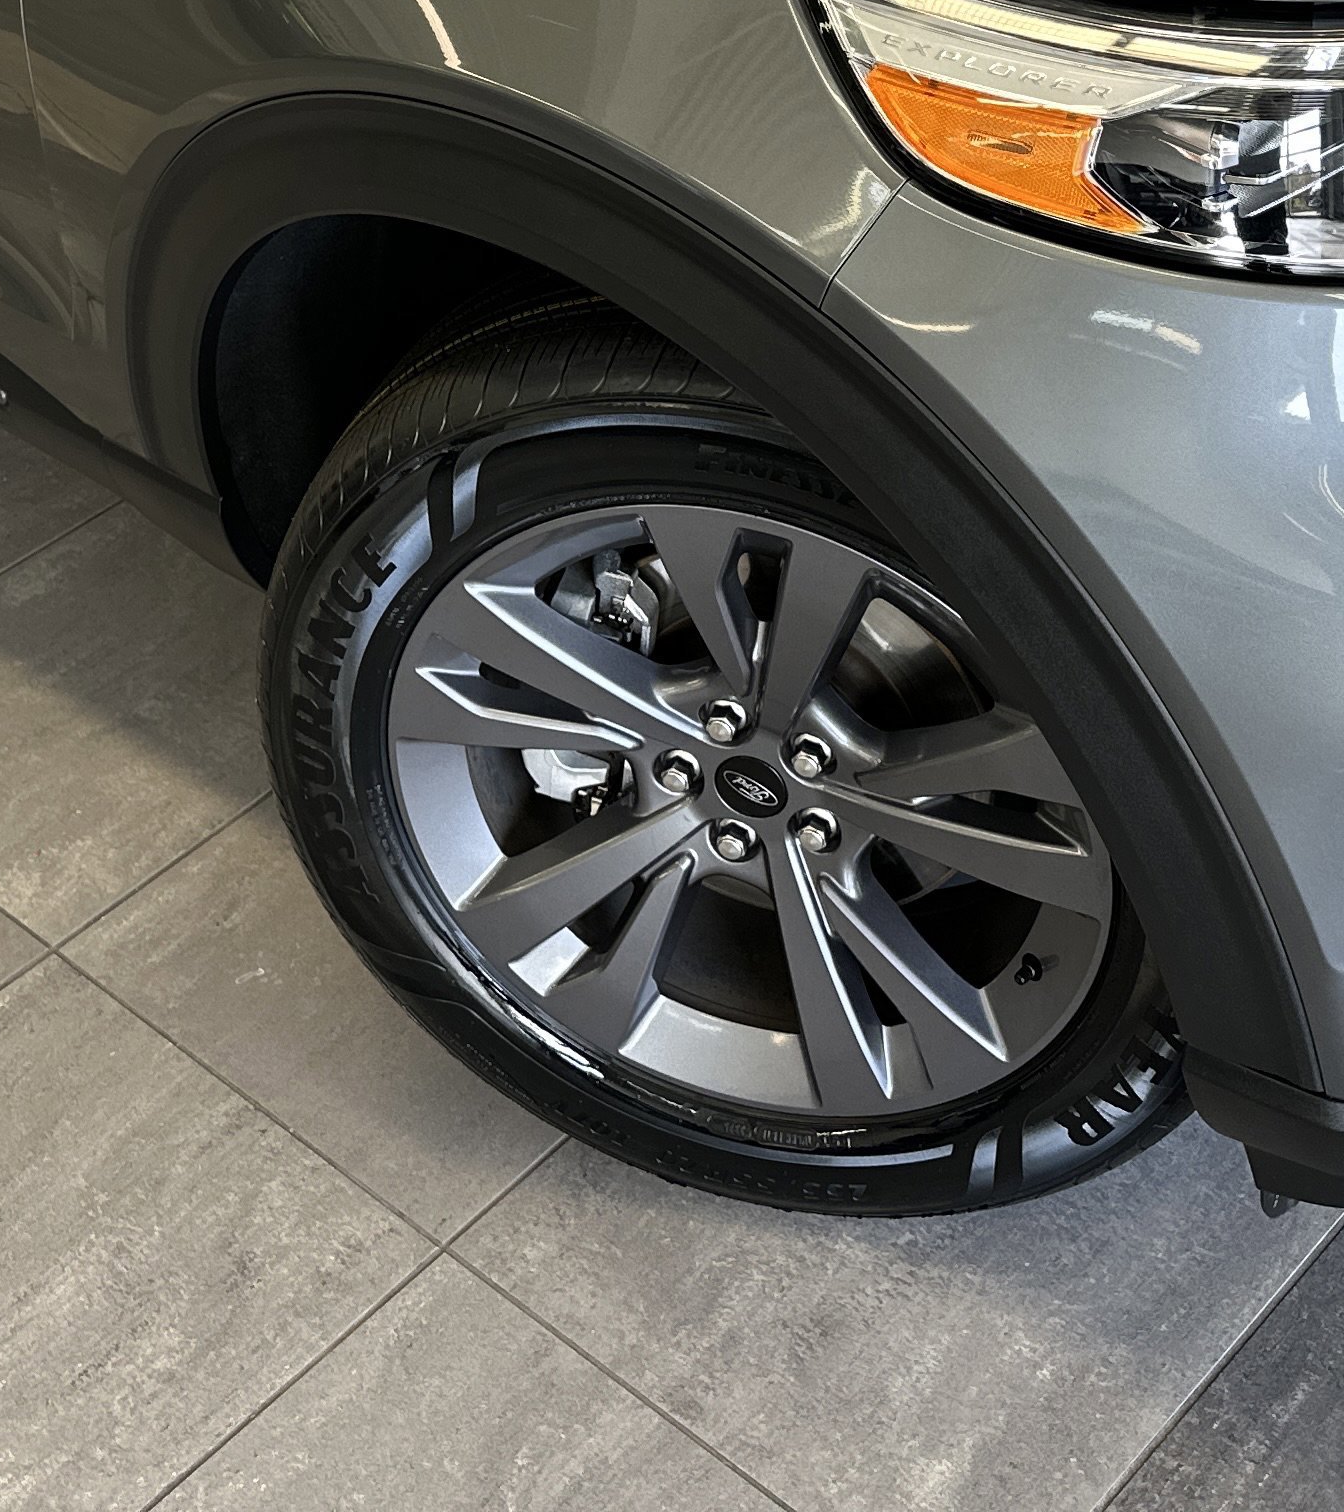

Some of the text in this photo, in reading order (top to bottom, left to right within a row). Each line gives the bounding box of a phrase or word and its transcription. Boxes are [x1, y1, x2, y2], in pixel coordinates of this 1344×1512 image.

[880, 33, 1114, 100] EXPLORER
[293, 532, 398, 904] ASSURANCE
[731, 776, 770, 802] Ford
